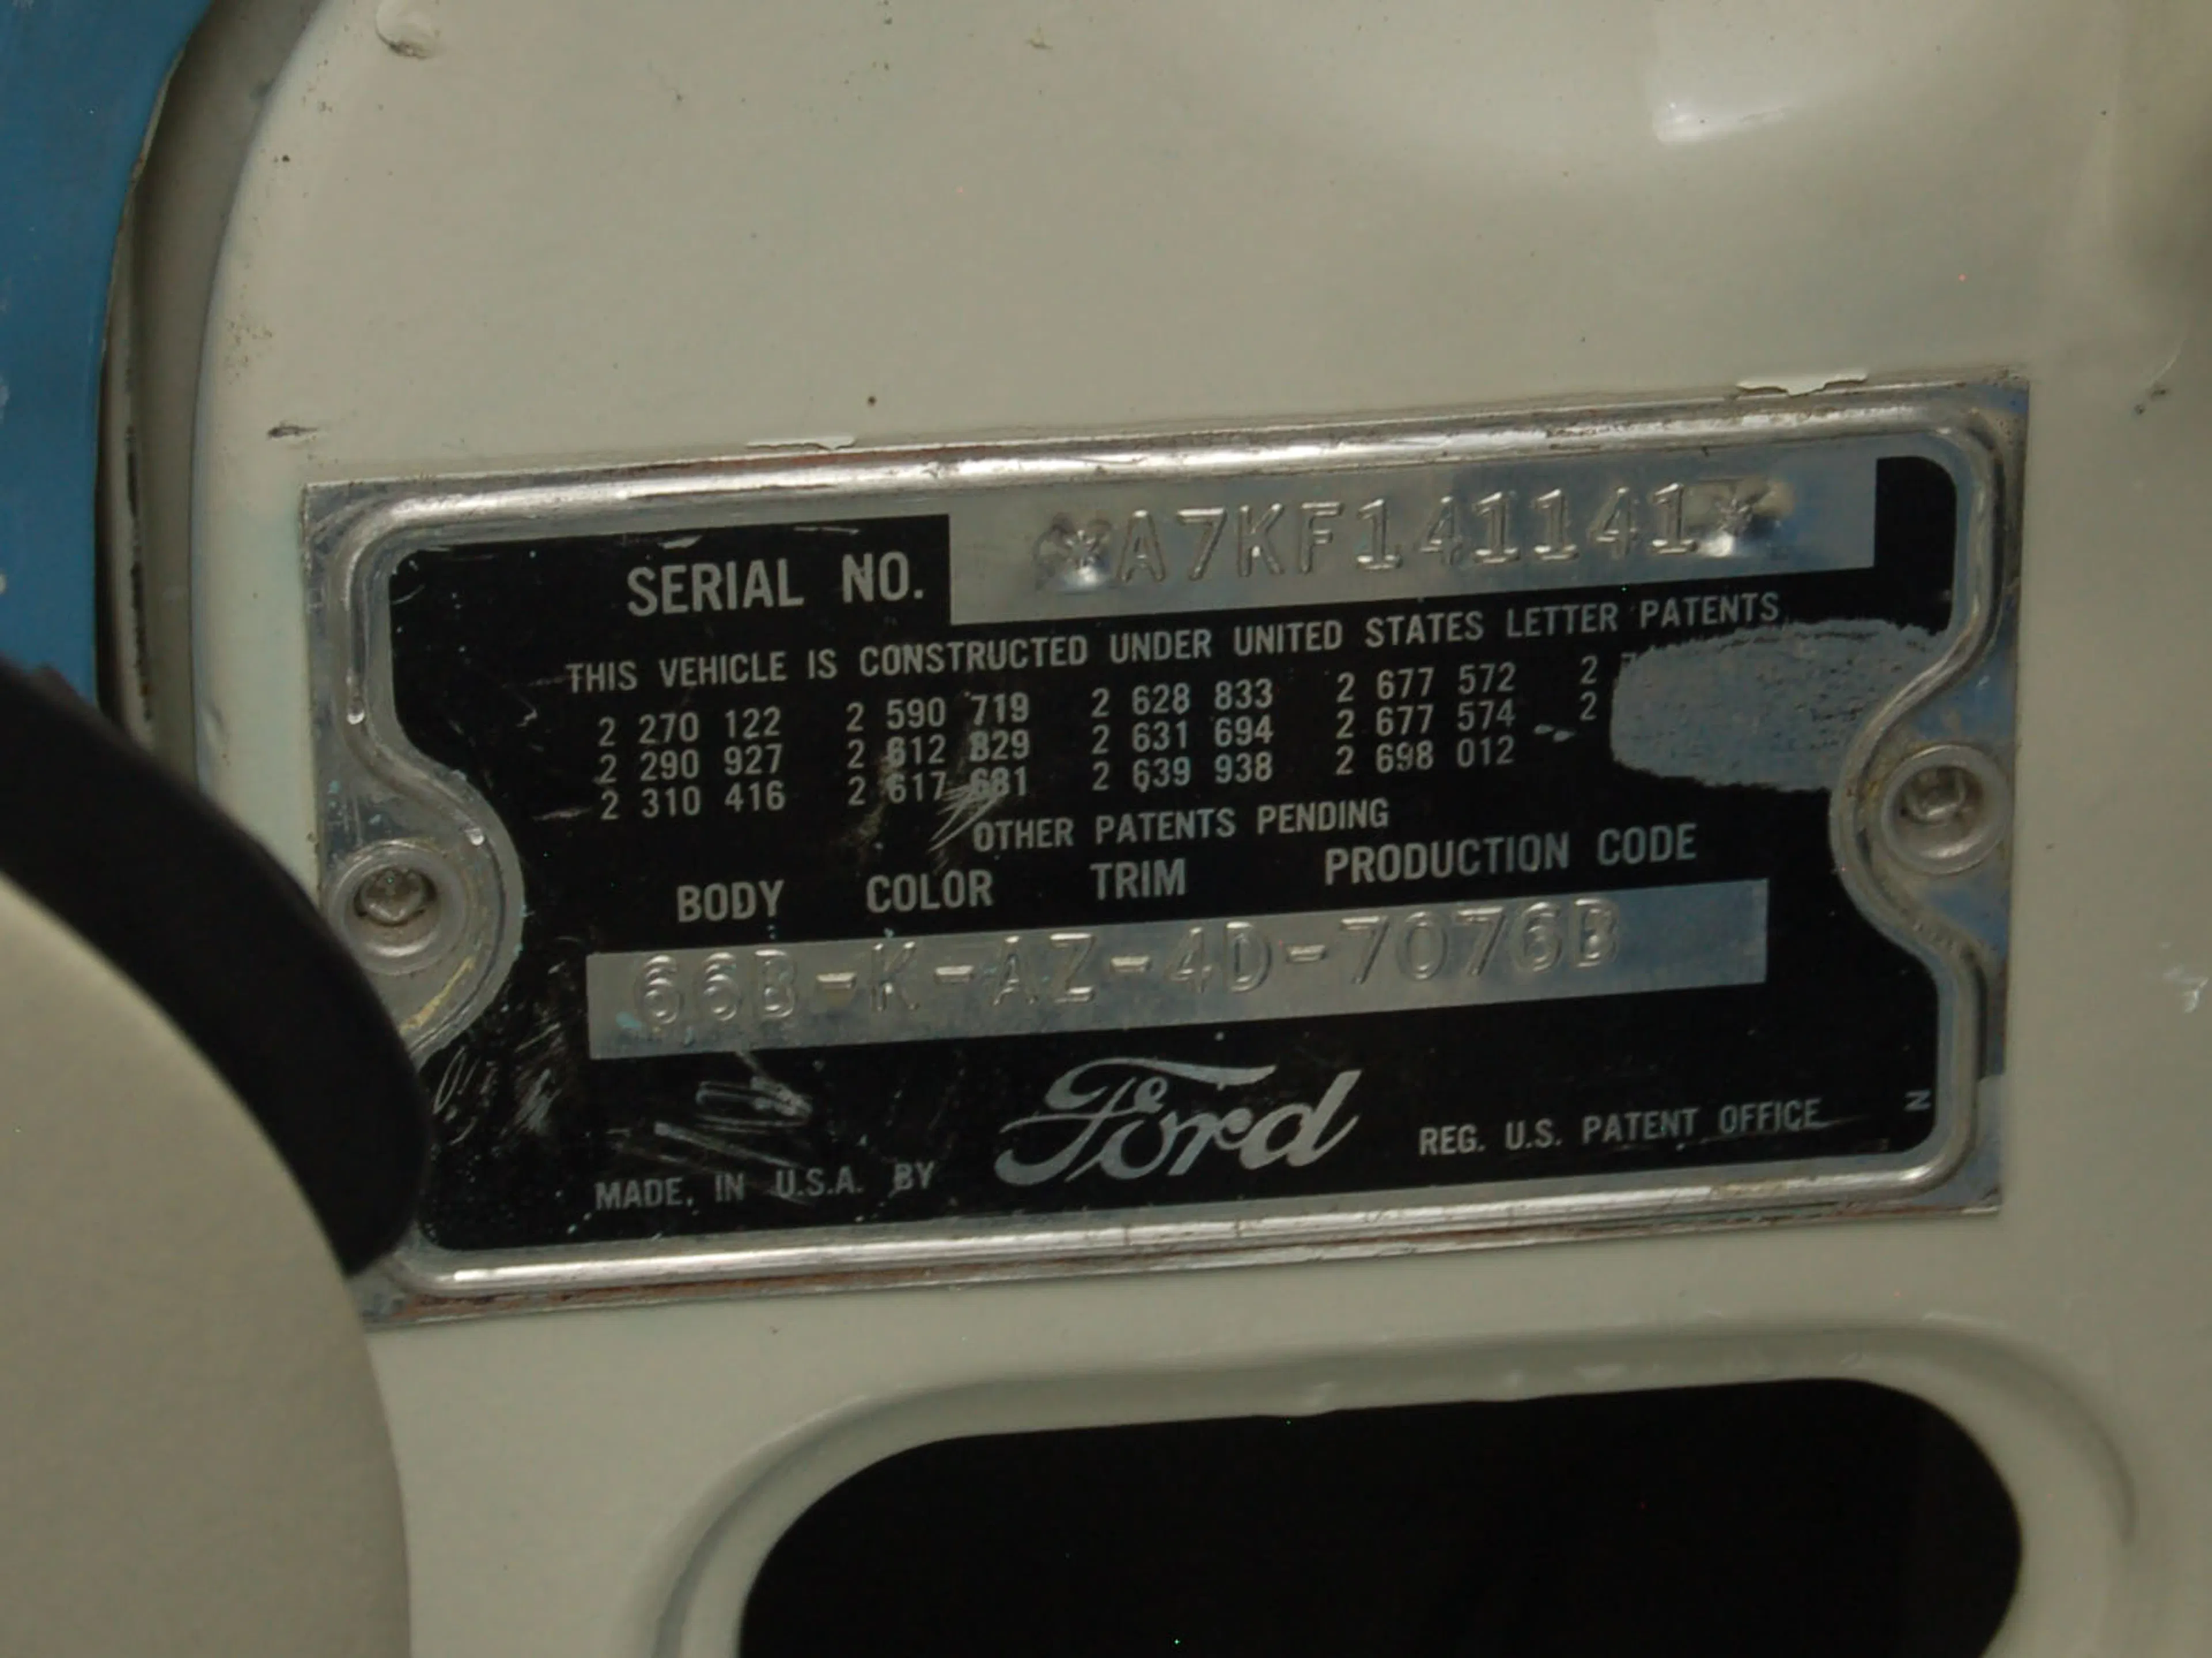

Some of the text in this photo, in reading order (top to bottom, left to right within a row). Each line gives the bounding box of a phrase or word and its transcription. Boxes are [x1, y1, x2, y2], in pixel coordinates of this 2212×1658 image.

[626, 551, 923, 617] SERIAL NO.
[566, 592, 1780, 693] THIS VEHICLE IS CONSTRUCTED UNDER UNITED STATES LETTER PATENTS
[1337, 663, 1516, 703] 2 677 572
[1580, 655, 1598, 685] 2
[846, 691, 1030, 733] 2 590 719
[1092, 678, 1274, 718] 2 628 833
[1580, 692, 1597, 721] 2
[599, 707, 782, 747] 2 270 122
[1092, 715, 1274, 755] 2 631 694
[1336, 700, 1516, 740] 2 677 574
[600, 743, 783, 784] 2 290 927
[847, 739, 865, 769] 2
[887, 734, 946, 768] 612
[1335, 736, 1515, 775] 2 698 012
[847, 776, 866, 806] 2
[887, 771, 948, 805] 617
[1092, 752, 1273, 792] 2 639 938
[601, 780, 786, 820] 2 310 416
[972, 798, 1390, 852] OTHER PATENTS PENDING
[1325, 822, 1698, 886] PRODUCTION CODE
[866, 868, 994, 915] COLOR
[1090, 857, 1188, 901] TRIM
[676, 879, 785, 924] BODY
[994, 1057, 1363, 1186] Ford
[1418, 1098, 1823, 1159] REG. U.S. PATENT OFFICE
[714, 1171, 746, 1204] IN
[775, 1163, 865, 1198] U.S.A.
[892, 1160, 937, 1192] BY
